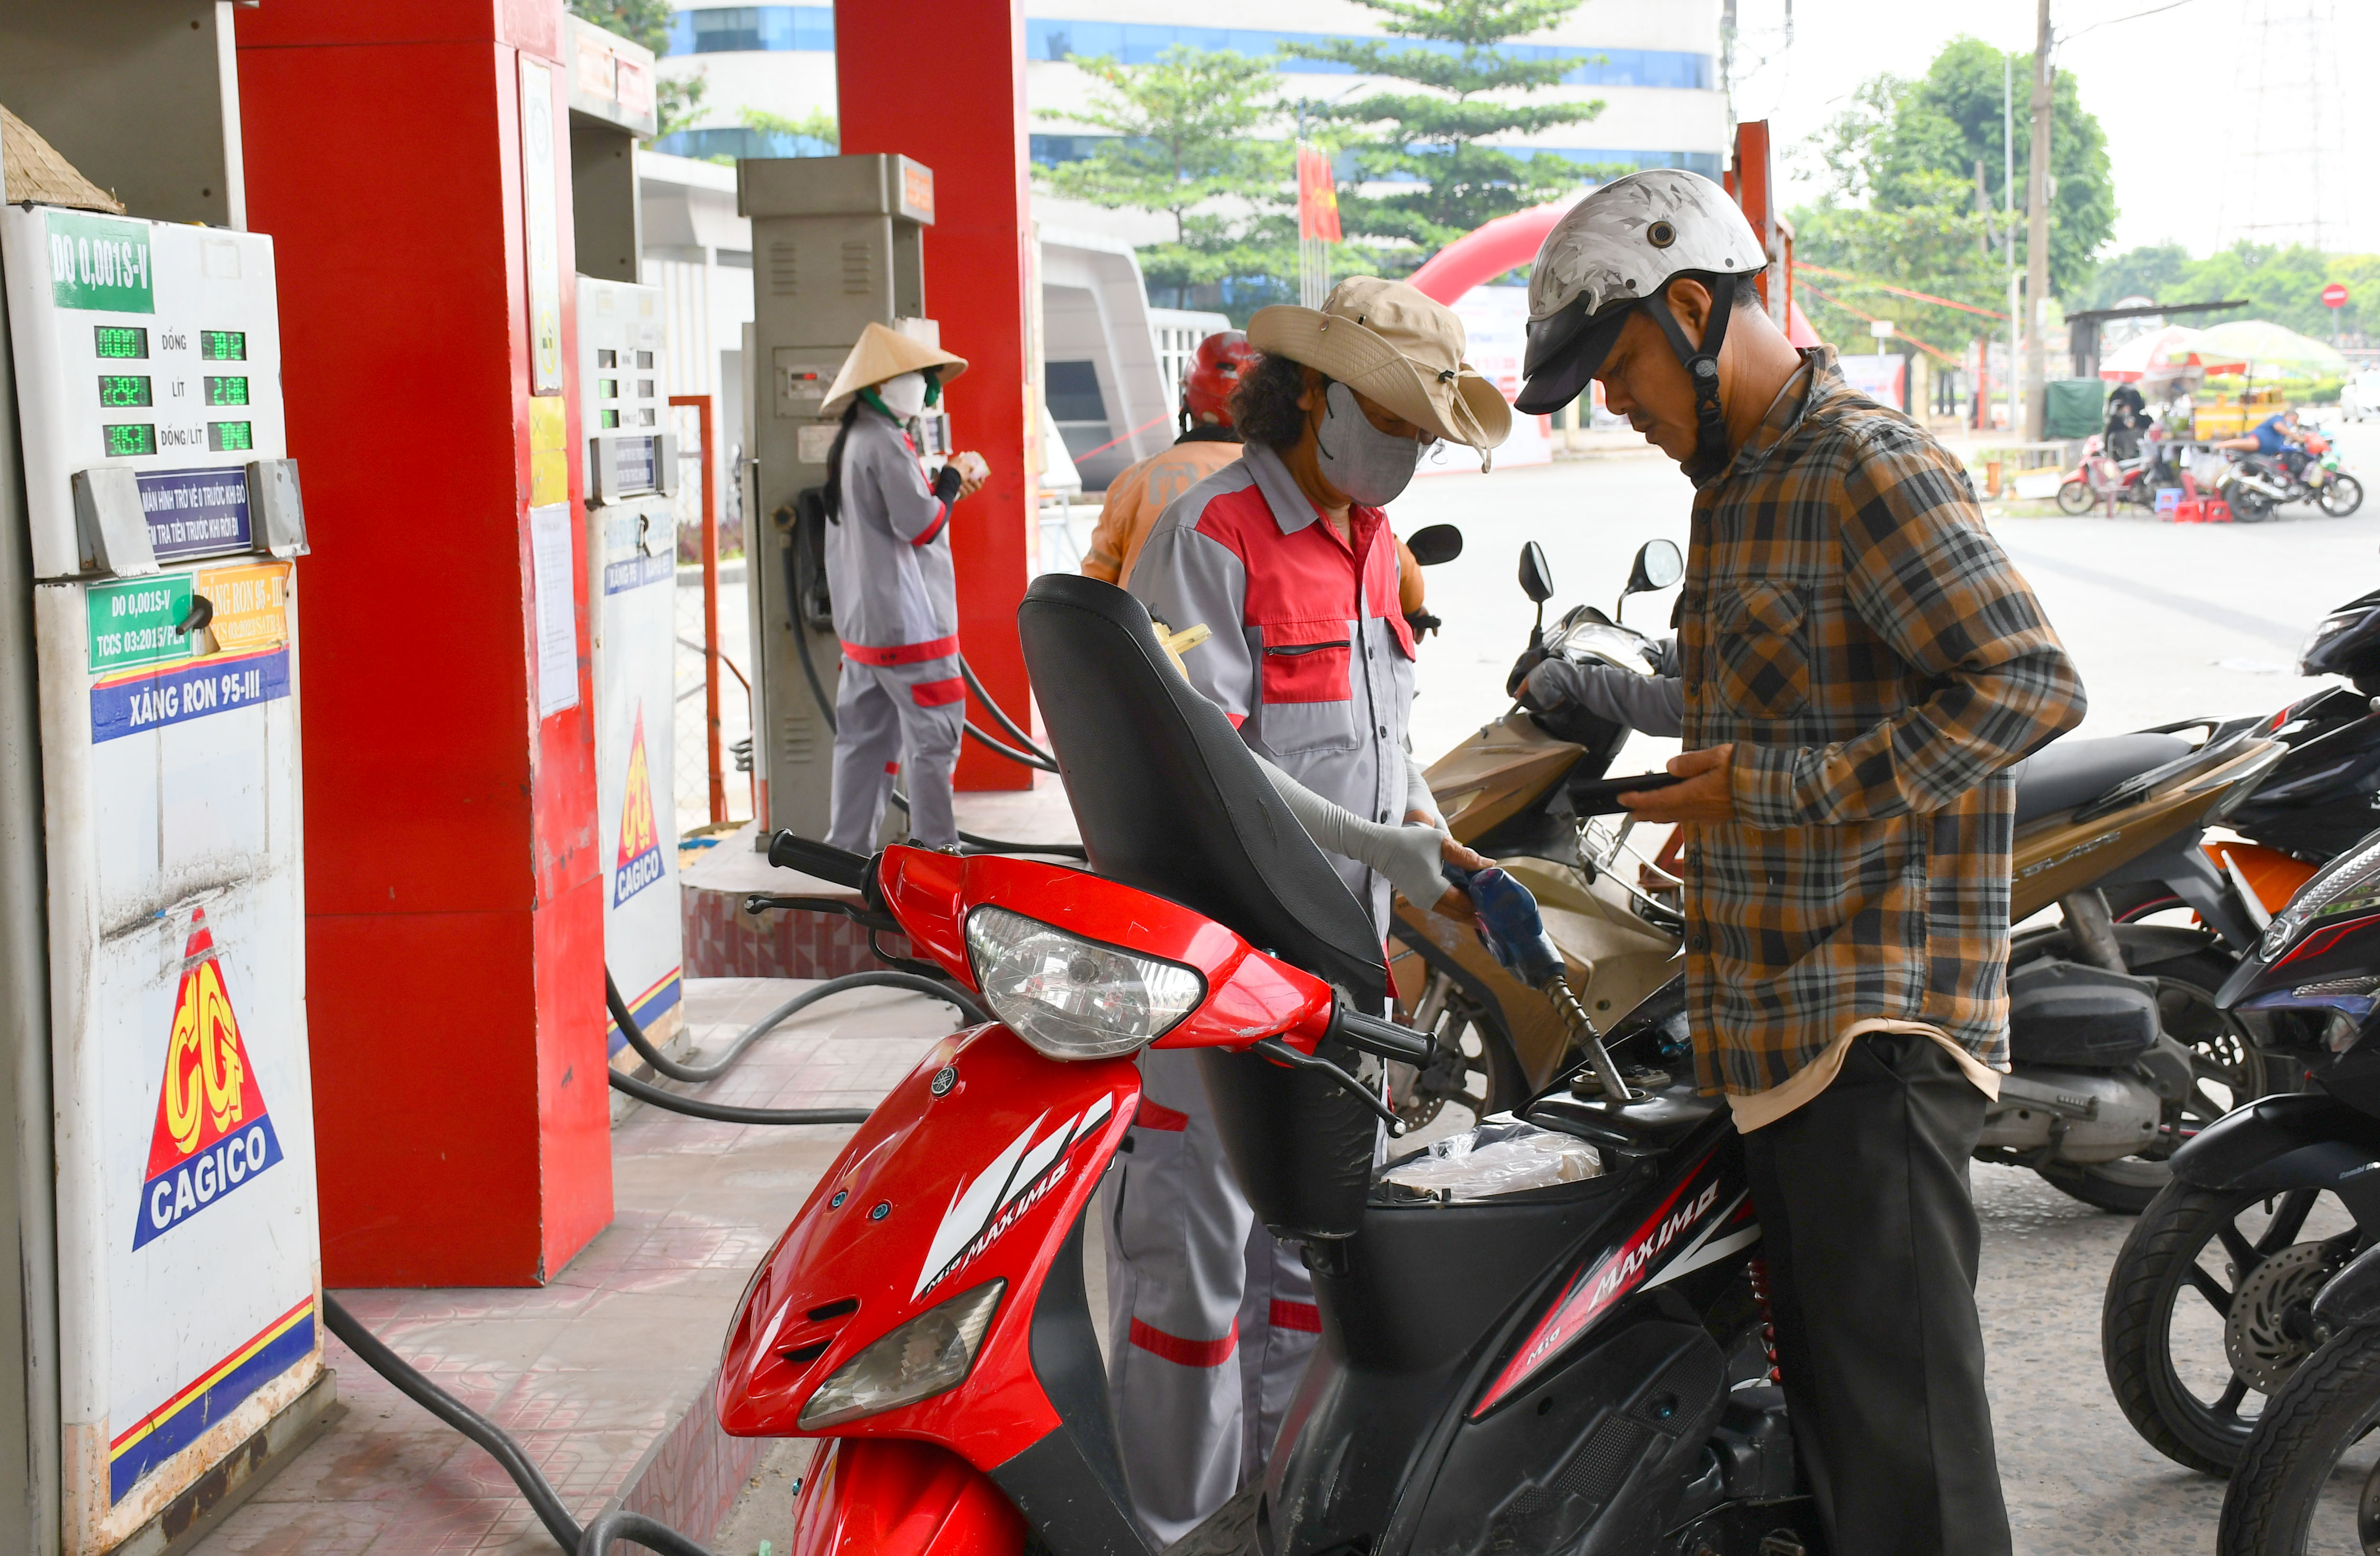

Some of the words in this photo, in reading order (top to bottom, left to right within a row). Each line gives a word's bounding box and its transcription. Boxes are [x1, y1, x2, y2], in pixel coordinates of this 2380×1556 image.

[51, 233, 76, 284] DO
[79, 237, 147, 291] 0,001S-V
[162, 326, 186, 350] ĐỒNG
[172, 376, 185, 397] LÍT
[157, 486, 175, 511] HÌNH
[225, 485, 236, 505] KHI
[156, 524, 172, 545] TRA
[171, 518, 186, 543] TIỀN
[209, 519, 220, 538] KHI
[112, 595, 126, 617] DO
[128, 589, 170, 618] 0,001S-V
[232, 580, 254, 614] RON
[97, 632, 122, 657] TCCS
[130, 686, 179, 727] XĂNG
[183, 677, 217, 713] RON
[221, 669, 260, 705] 95-III
[618, 852, 659, 902] CAGICO
[150, 1125, 267, 1230] CAGICO
